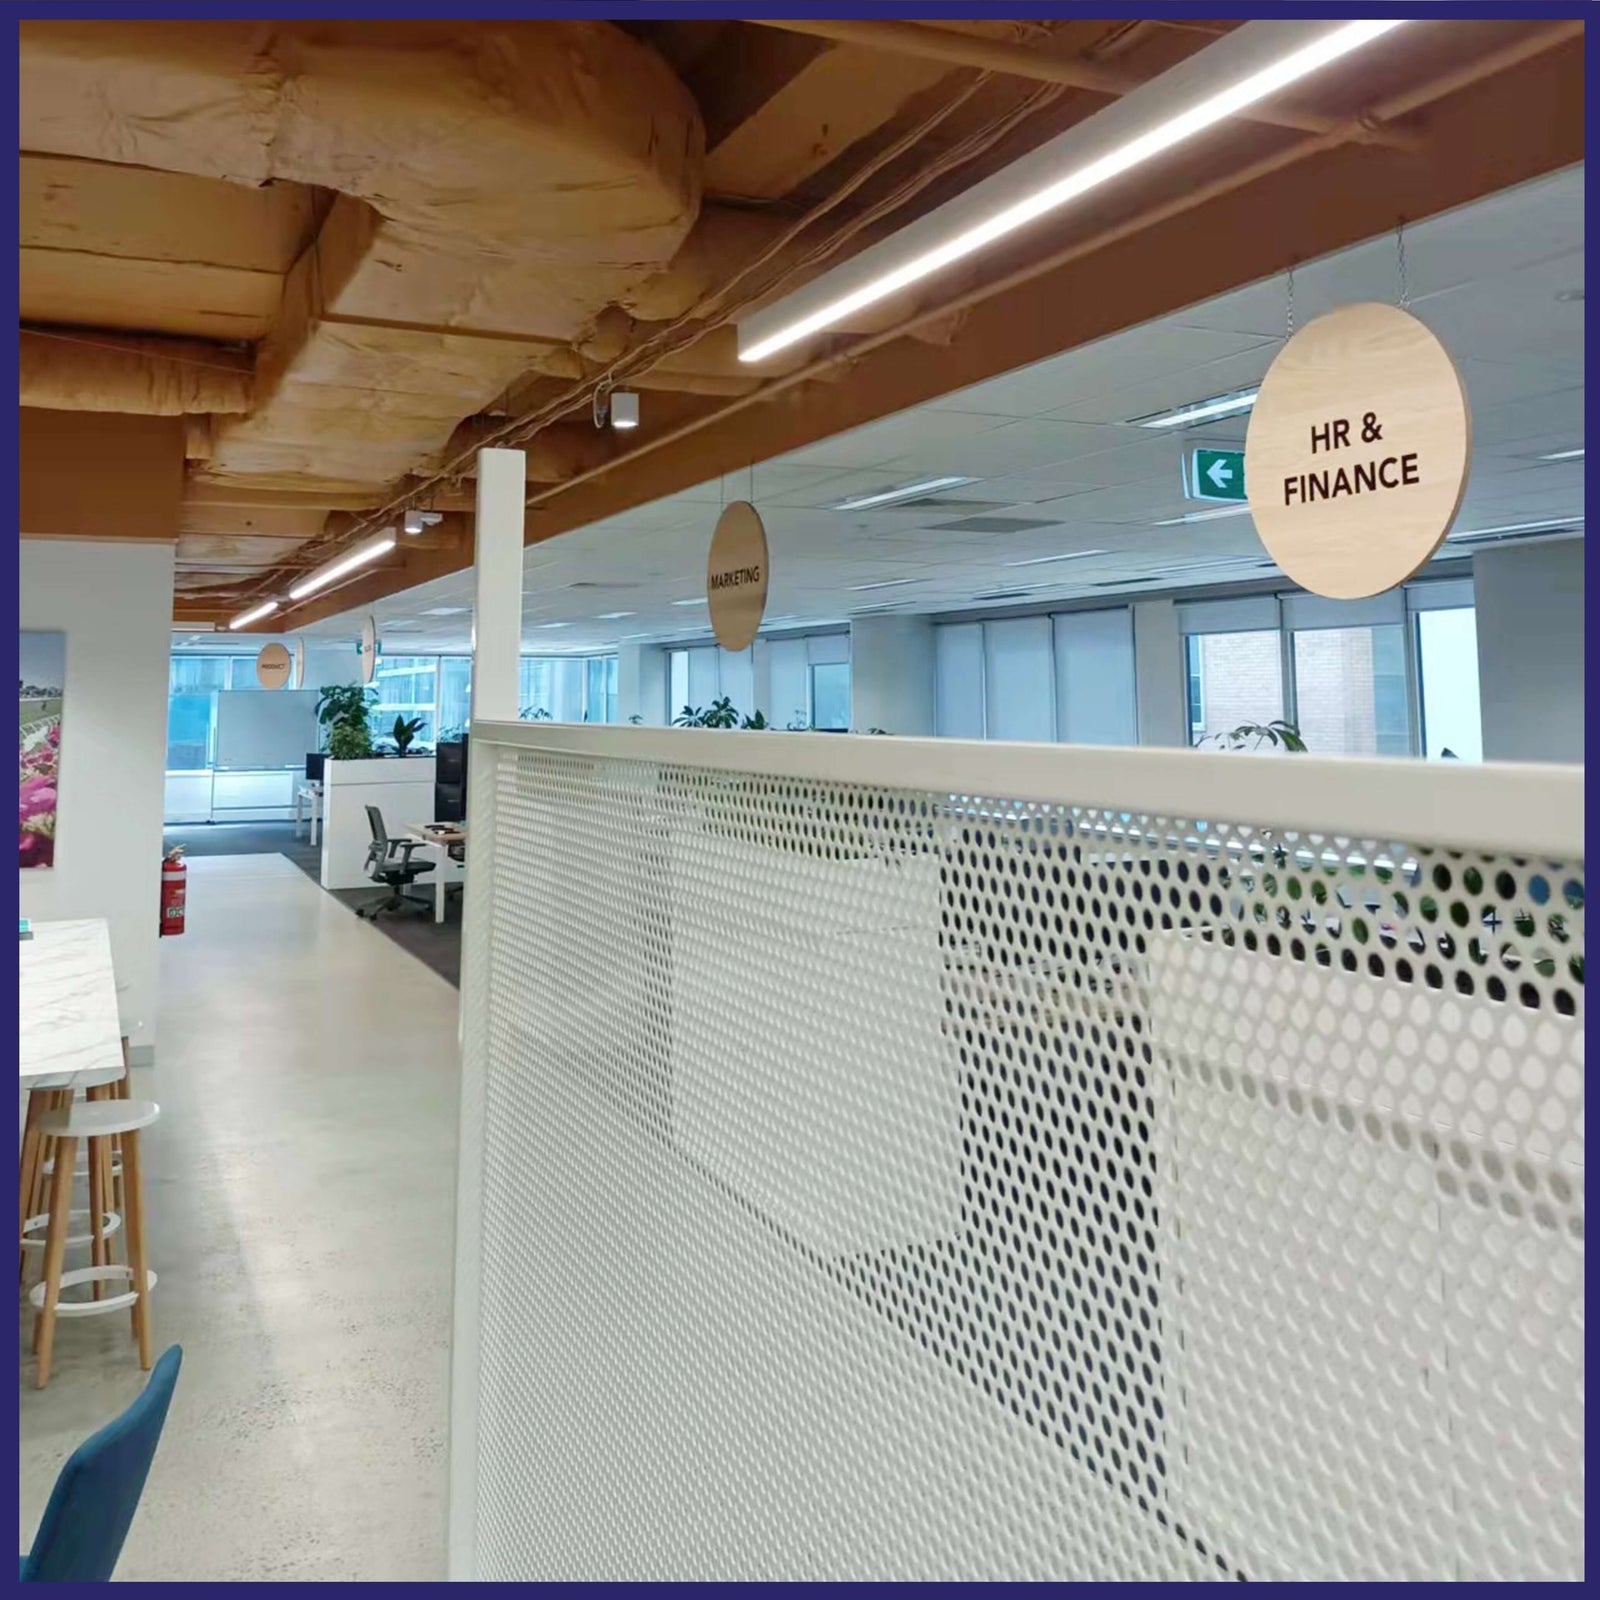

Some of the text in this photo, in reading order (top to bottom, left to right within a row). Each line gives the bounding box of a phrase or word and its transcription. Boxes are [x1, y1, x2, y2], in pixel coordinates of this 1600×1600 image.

[1311, 412, 1383, 454] HR &
[1284, 453, 1419, 506] FINANCE
[711, 565, 760, 591] MARKETING
